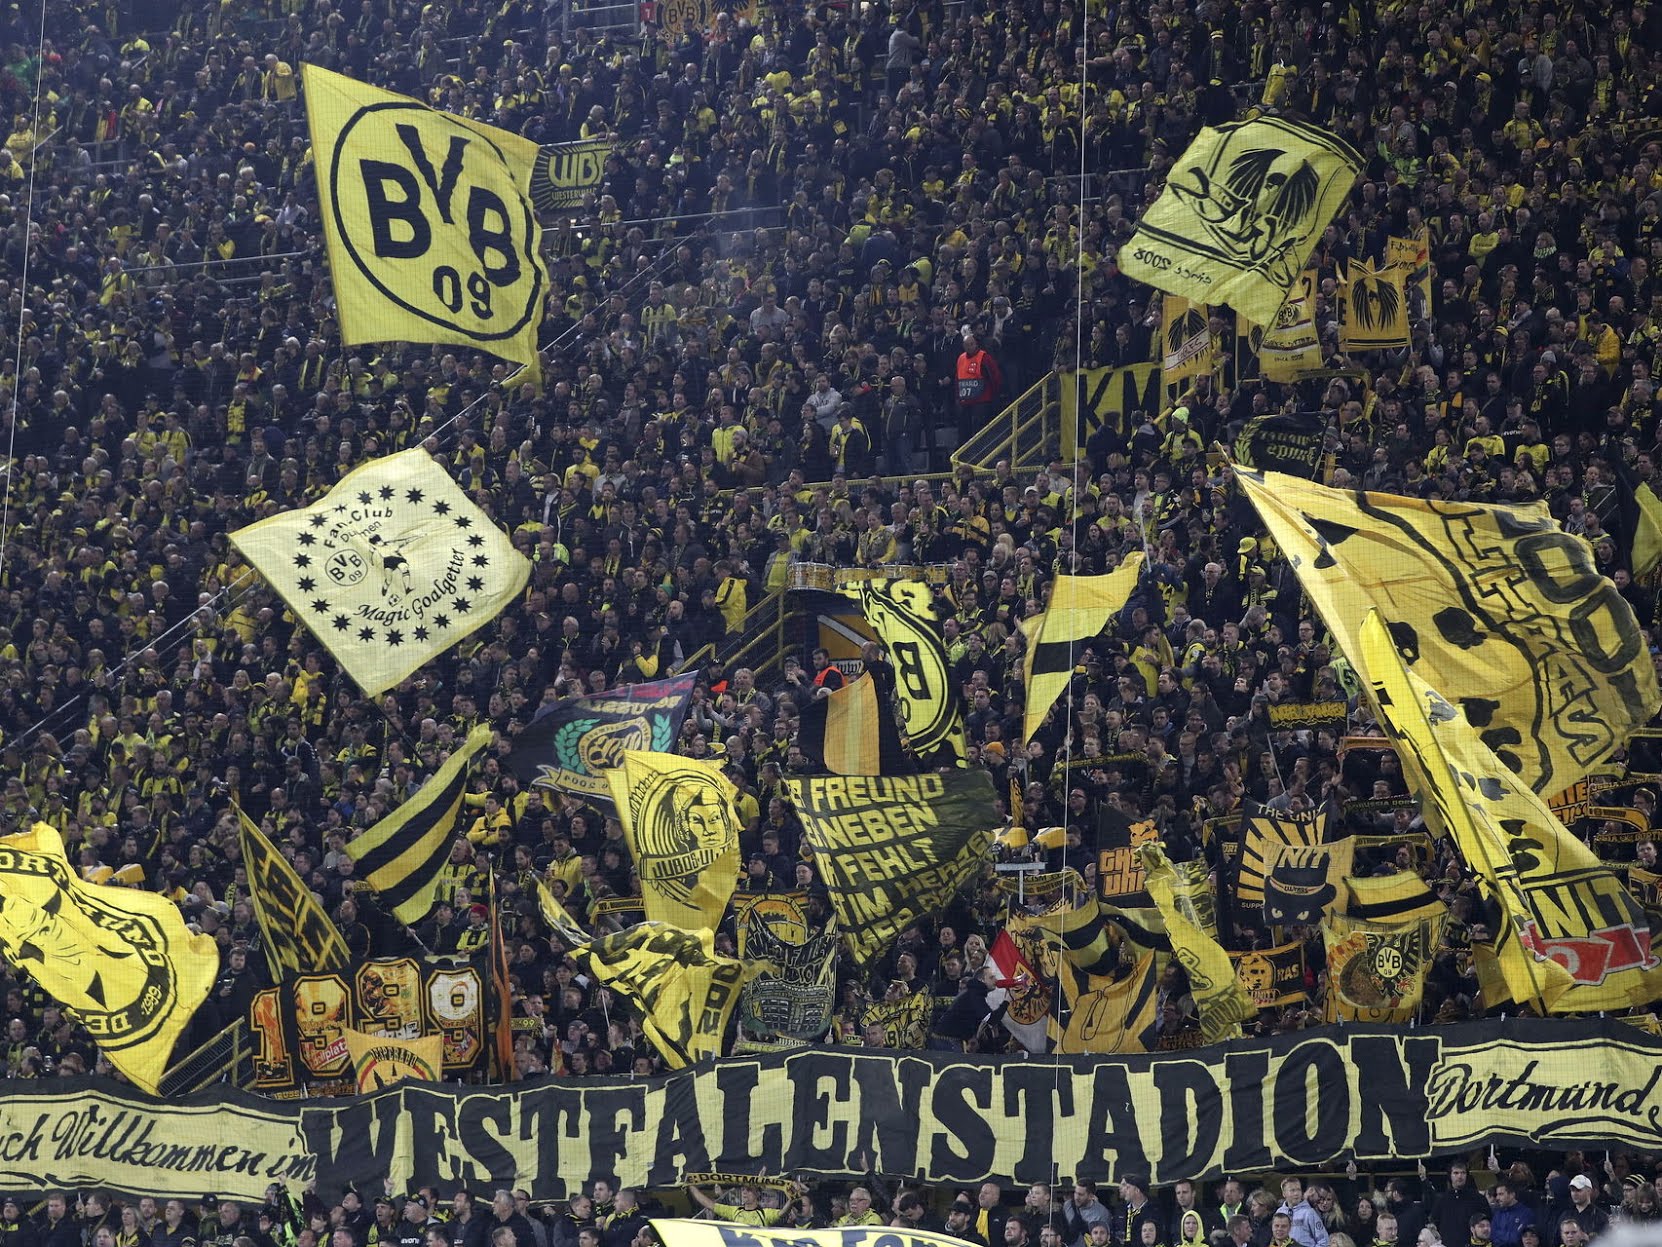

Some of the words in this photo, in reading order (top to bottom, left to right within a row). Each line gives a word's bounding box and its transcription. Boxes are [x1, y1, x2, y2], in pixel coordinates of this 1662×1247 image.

[359, 122, 522, 288] BVB
[432, 264, 494, 321] 09
[323, 507, 394, 549] Fan-Club
[329, 553, 363, 582] BVB
[348, 569, 363, 583] 09
[352, 603, 411, 627] Magic
[411, 547, 466, 620] Goalgetter
[810, 773, 946, 813] FREUND
[1257, 803, 1286, 821] THE
[817, 801, 939, 850] NEBEN
[835, 837, 939, 887] FEHLT
[847, 886, 895, 926] IM
[1378, 947, 1402, 969] BVB
[1383, 969, 1394, 977] 09
[1426, 1059, 1662, 1120] Dortmund
[301, 1036, 1443, 1204] WESTFALENSTADION
[51, 1103, 267, 1177] Willkommen
[266, 1137, 319, 1183] im
[699, 1173, 788, 1188] DORTMUND
